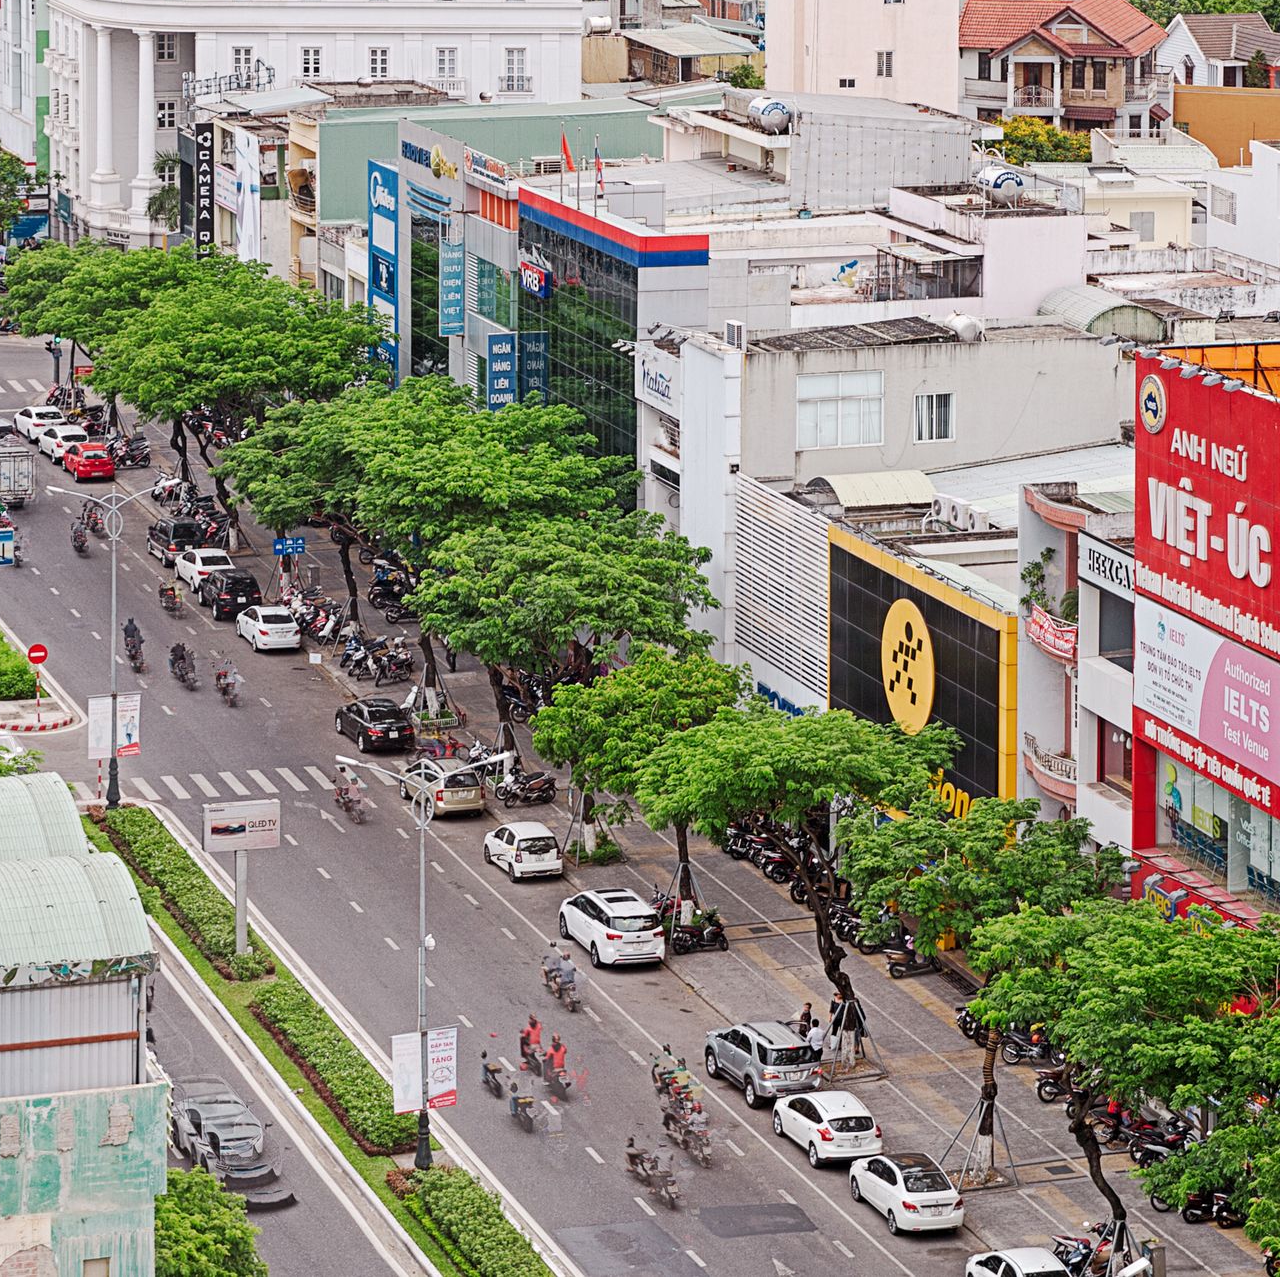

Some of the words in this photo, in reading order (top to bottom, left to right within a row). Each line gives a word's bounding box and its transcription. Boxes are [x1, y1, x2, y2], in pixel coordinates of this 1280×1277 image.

[199, 150, 211, 220] CAMERA
[521, 267, 541, 293] VRB
[490, 392, 514, 405] DOANH
[1170, 427, 1206, 465] ANH
[1211, 444, 1248, 482] NGỮ
[1088, 548, 1134, 591] HEEKCA
[1169, 628, 1186, 647] IELTS
[1234, 607, 1260, 644] English
[1140, 641, 1156, 658] TRUNG
[1188, 665, 1202, 681] IELTS
[1224, 658, 1270, 695] Authorized
[1185, 680, 1194, 693] THI
[1224, 685, 1270, 733] IELTS
[1223, 721, 1241, 745] Test
[1243, 732, 1270, 761] Venue
[248, 820, 267, 829] QLED
[268, 819, 277, 827] TV
